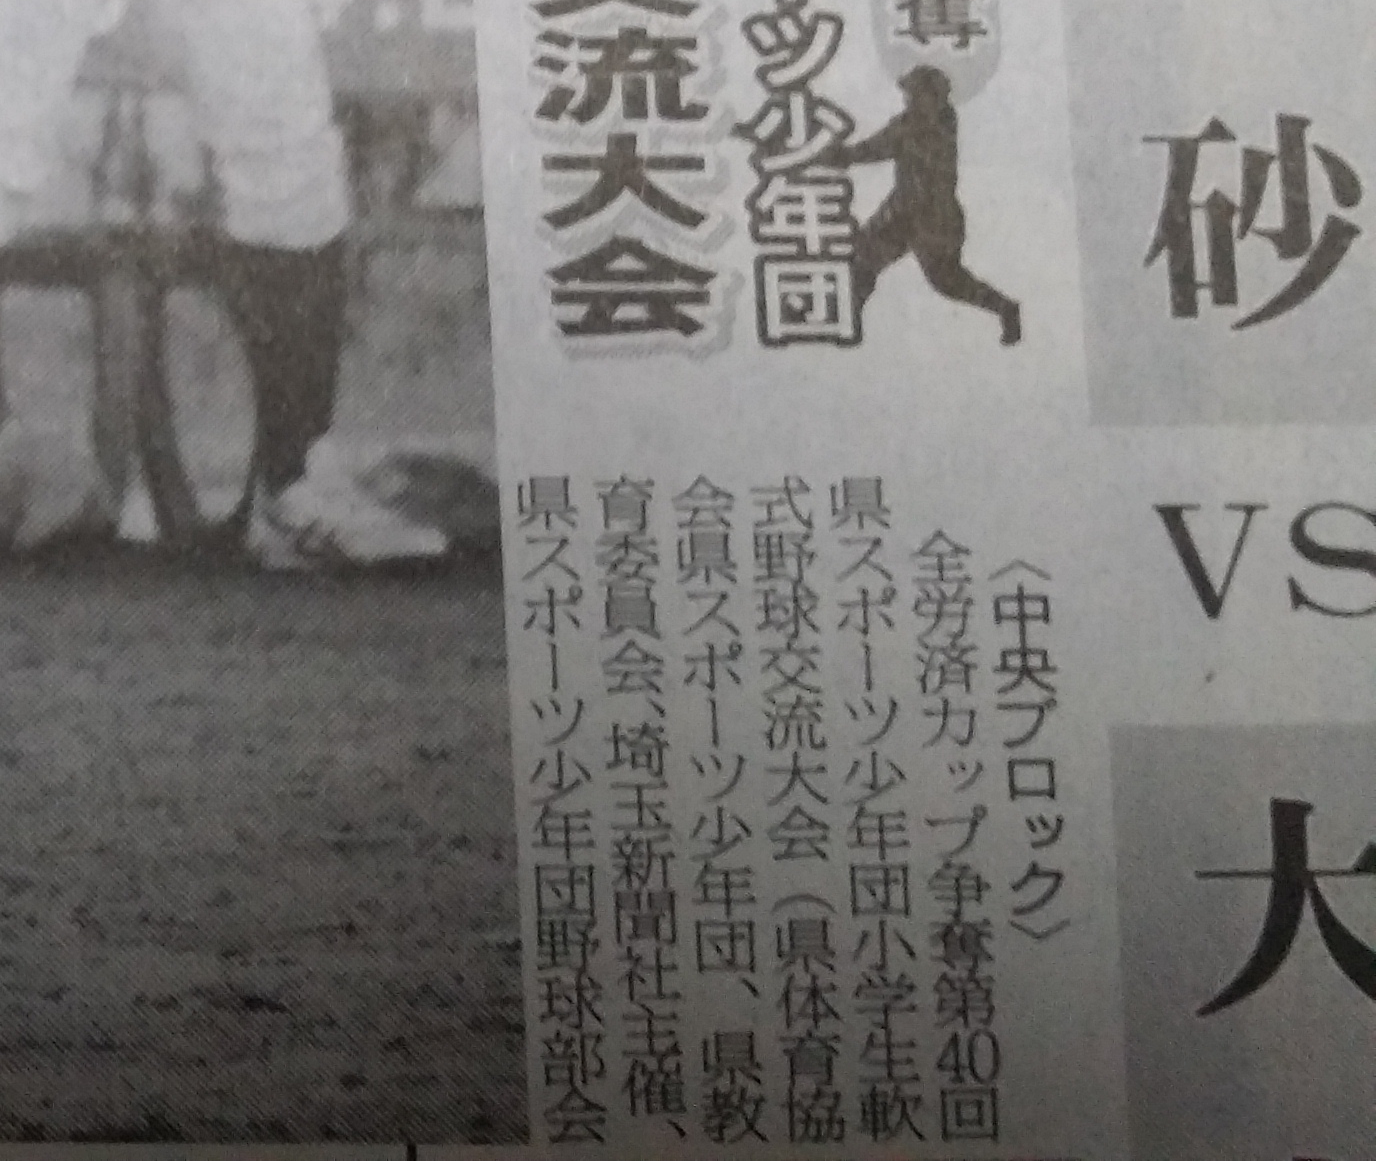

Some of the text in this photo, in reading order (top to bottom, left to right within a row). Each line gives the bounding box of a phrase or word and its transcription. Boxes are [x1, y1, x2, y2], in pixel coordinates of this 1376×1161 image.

[516, 474, 609, 1143] 県スポーツ少年団野球部会
[829, 475, 926, 1142] 県スポーツ少年団小学生軟
[912, 529, 1002, 1142] 全労済カップ争奪第40回
